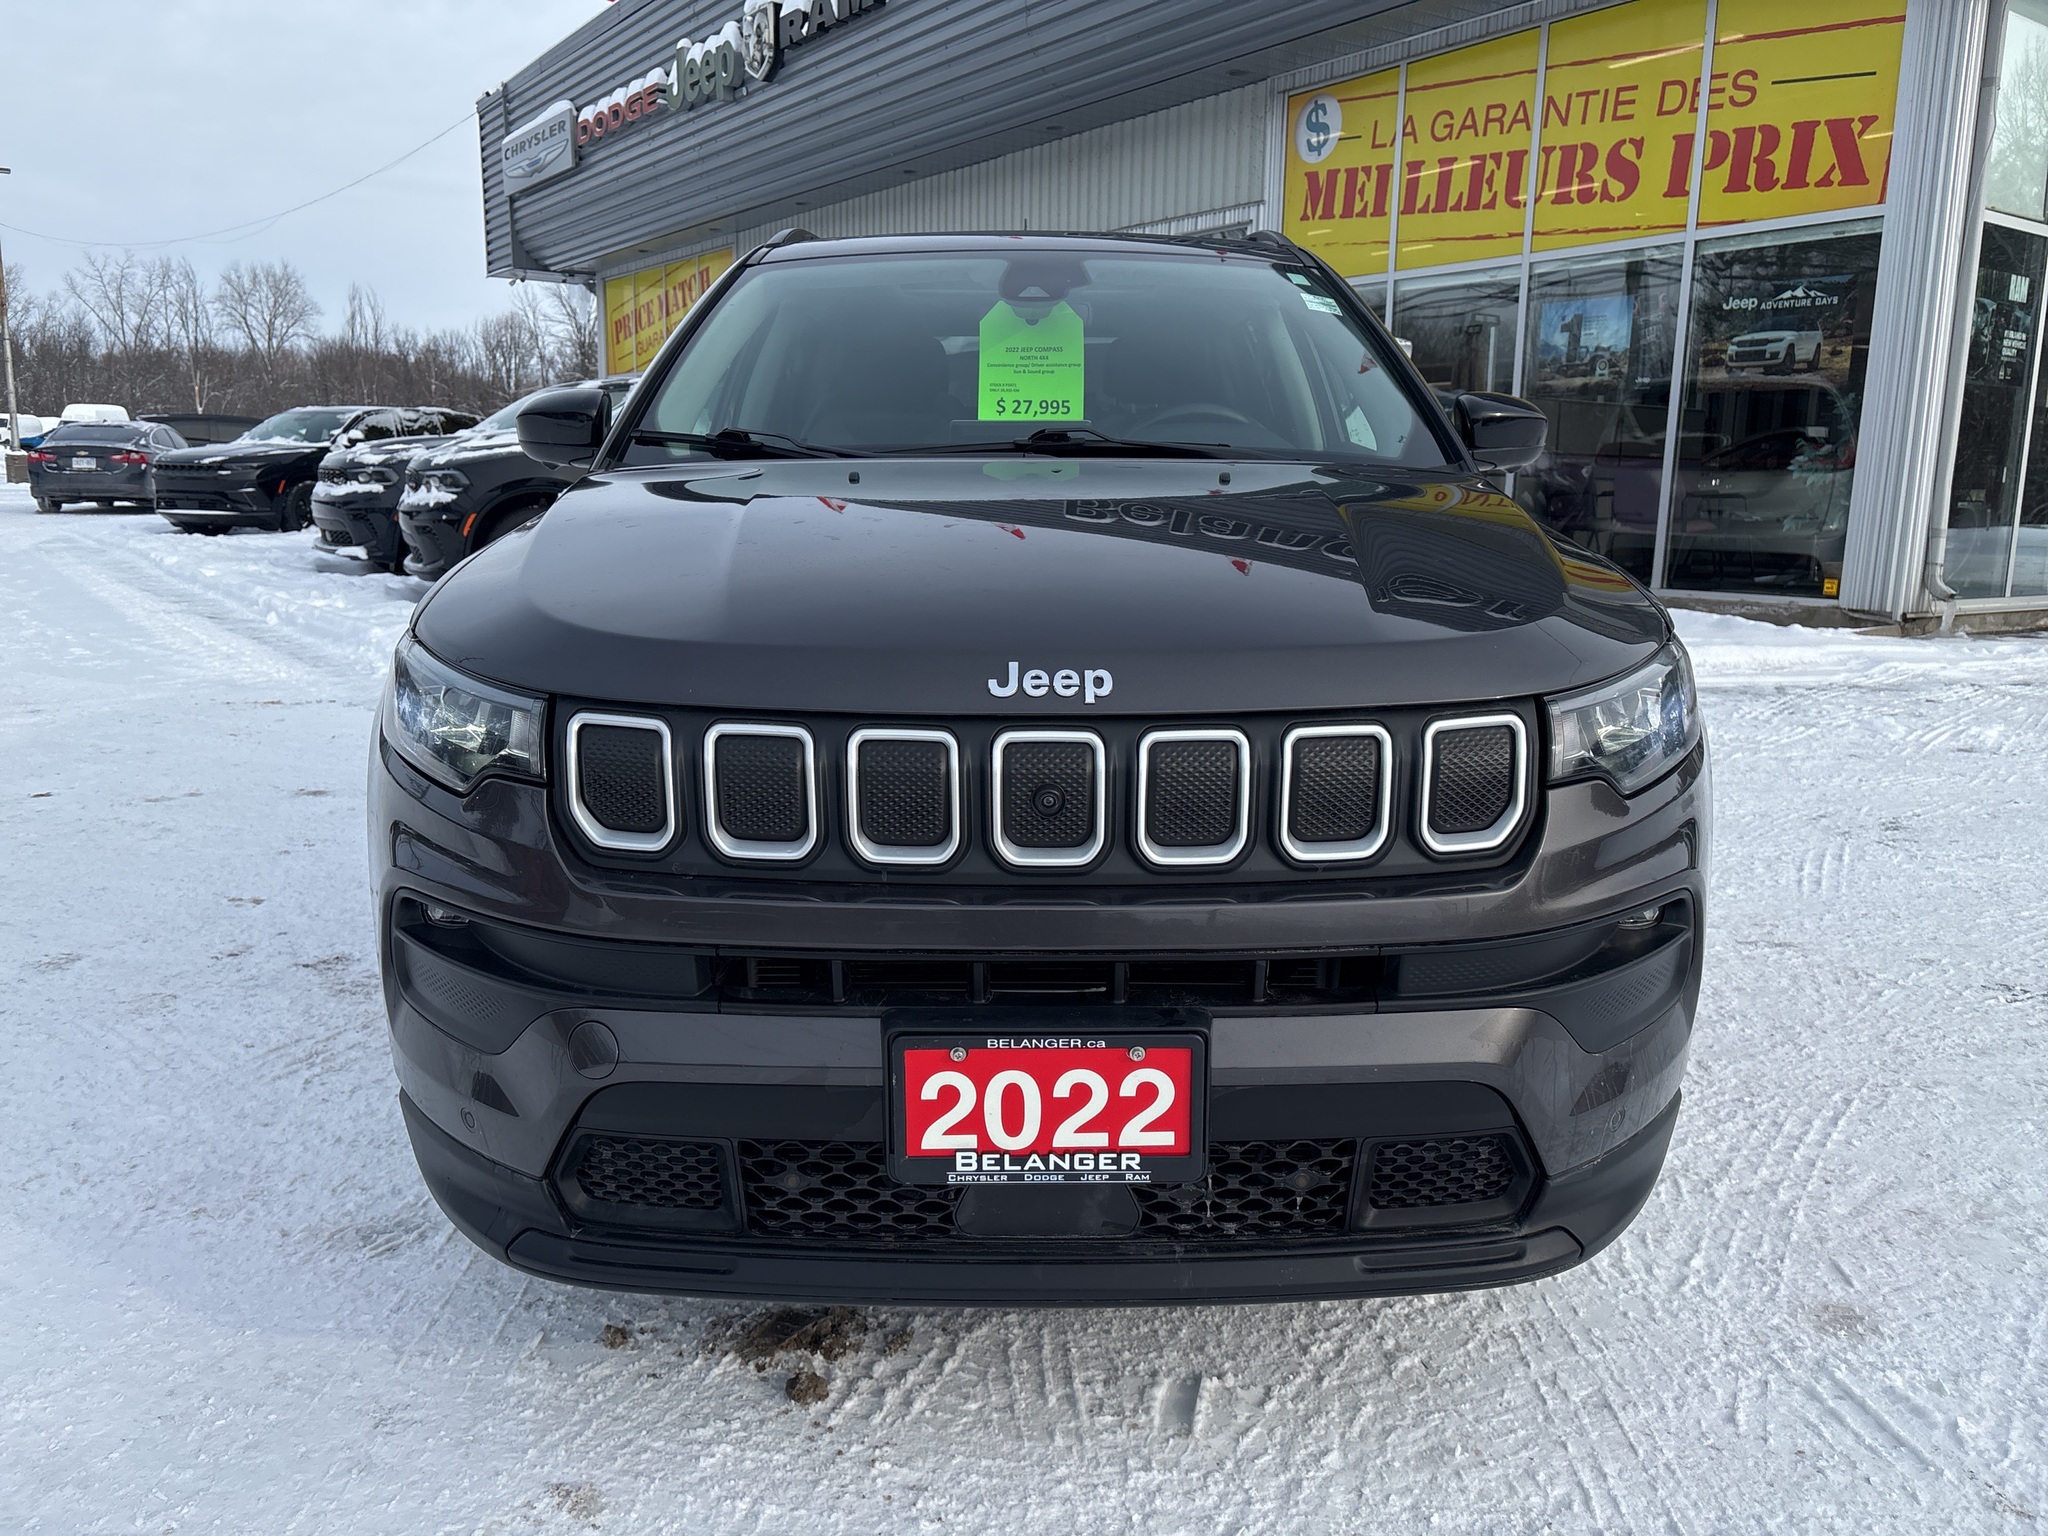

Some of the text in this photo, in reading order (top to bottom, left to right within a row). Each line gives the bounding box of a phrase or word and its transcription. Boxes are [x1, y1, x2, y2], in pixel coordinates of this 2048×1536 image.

[667, 40, 735, 110] Jeep
[577, 82, 660, 145] DODGE
[1371, 69, 1759, 149] LA GARANTIE DES
[503, 119, 567, 161] CHRYSLER
[1299, 114, 1879, 222] MEILLEURS PRIX
[614, 266, 711, 345] PRICE MATCH
[1723, 296, 1758, 311] Jeep
[1760, 296, 1839, 311] ADVENTURE DAYS
[996, 397, 1071, 417] $ 27,995
[988, 661, 1113, 704] Jeep
[987, 1038, 1106, 1049] BELANGER.ca
[920, 1068, 1176, 1150] 2022
